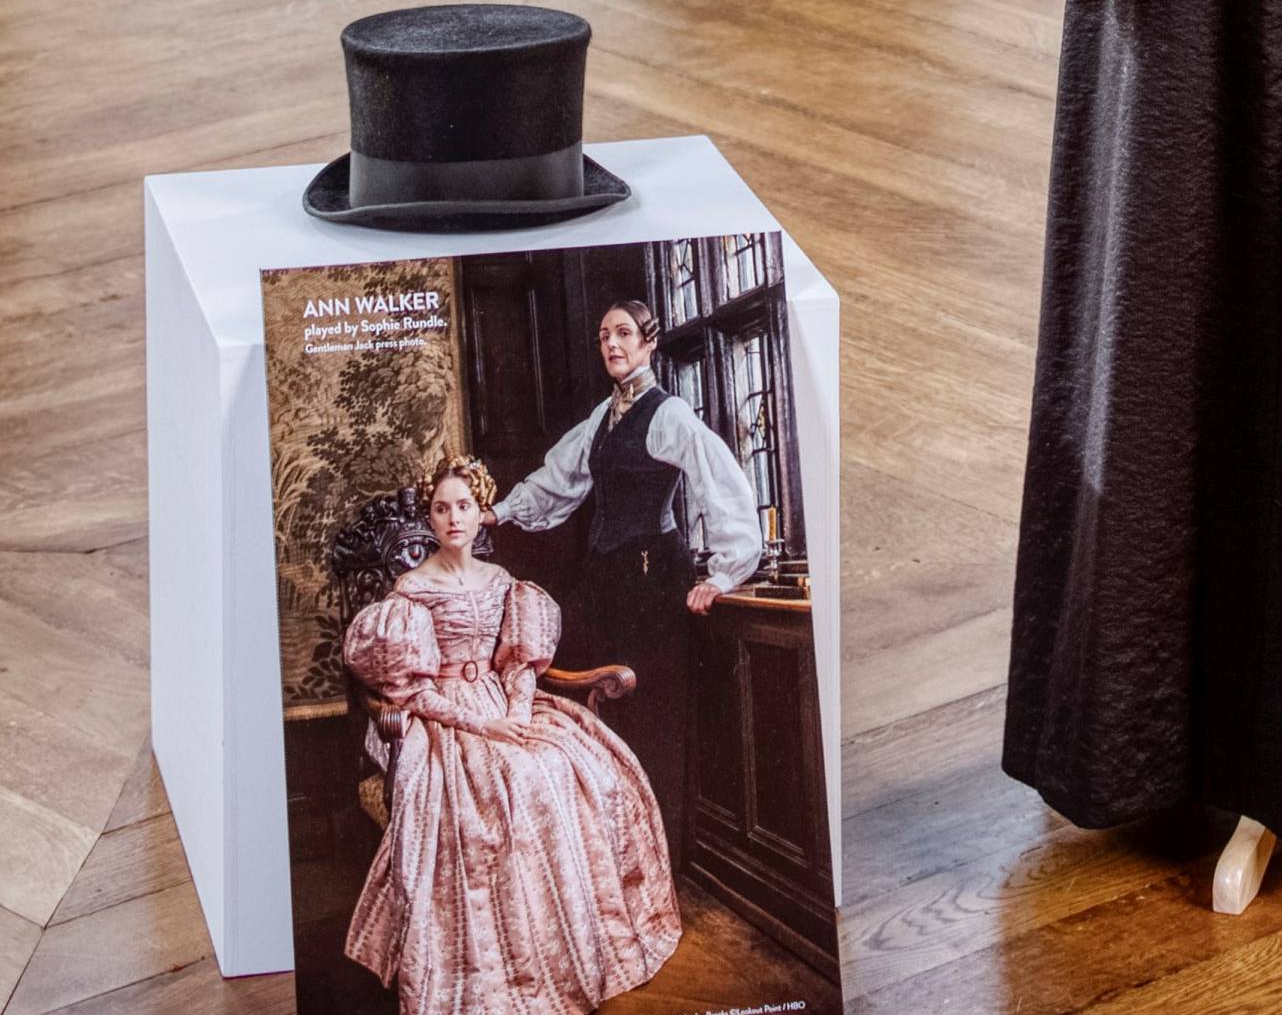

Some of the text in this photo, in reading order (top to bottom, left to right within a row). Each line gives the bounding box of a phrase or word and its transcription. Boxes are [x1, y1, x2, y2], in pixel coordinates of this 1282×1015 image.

[303, 291, 439, 318] ANN WALKER
[304, 315, 448, 341] played by Sophie Rundle.
[305, 337, 427, 354] Gentleman Jack press photo.
[764, 1004, 781, 1013] Point
[787, 1000, 806, 1010] HBO
